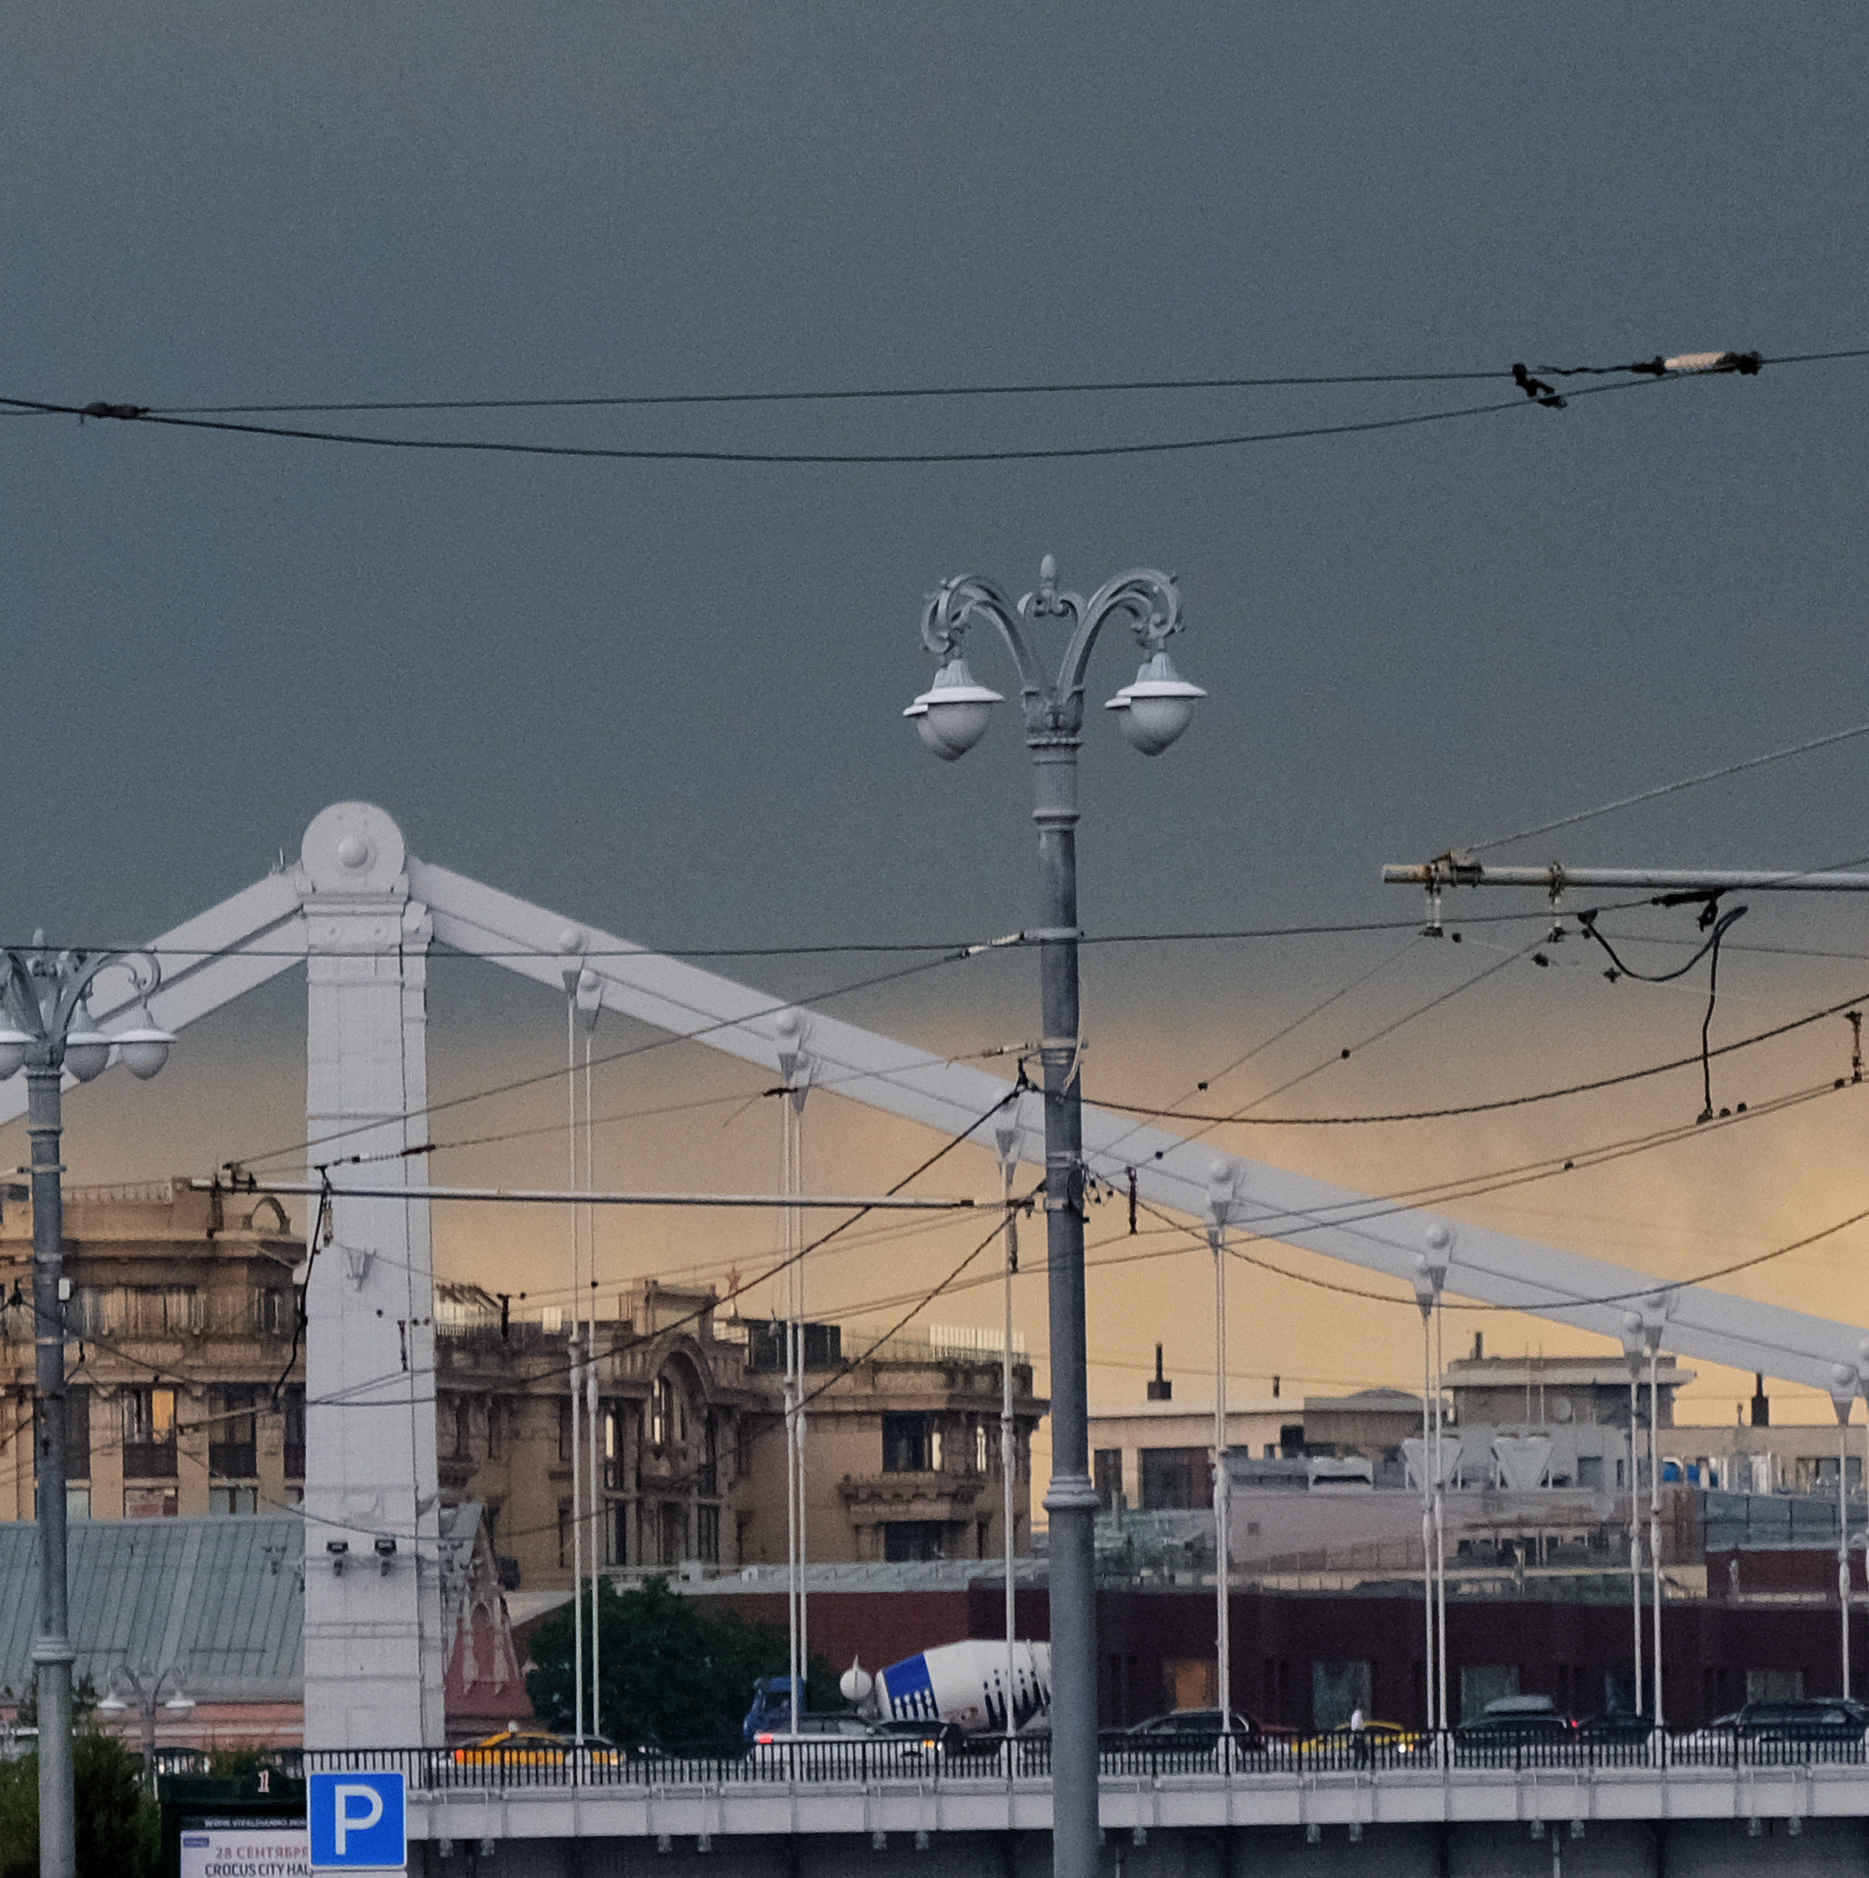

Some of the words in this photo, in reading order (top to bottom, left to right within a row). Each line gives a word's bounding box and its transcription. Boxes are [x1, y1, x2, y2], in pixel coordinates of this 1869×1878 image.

[334, 1784, 383, 1856] P
[215, 1847, 233, 1859] 28
[236, 1846, 309, 1859] СЕНТЯБРЯ
[204, 1863, 257, 1878] CROCUS
[258, 1863, 285, 1877] CITY
[286, 1862, 309, 1876] HAL
